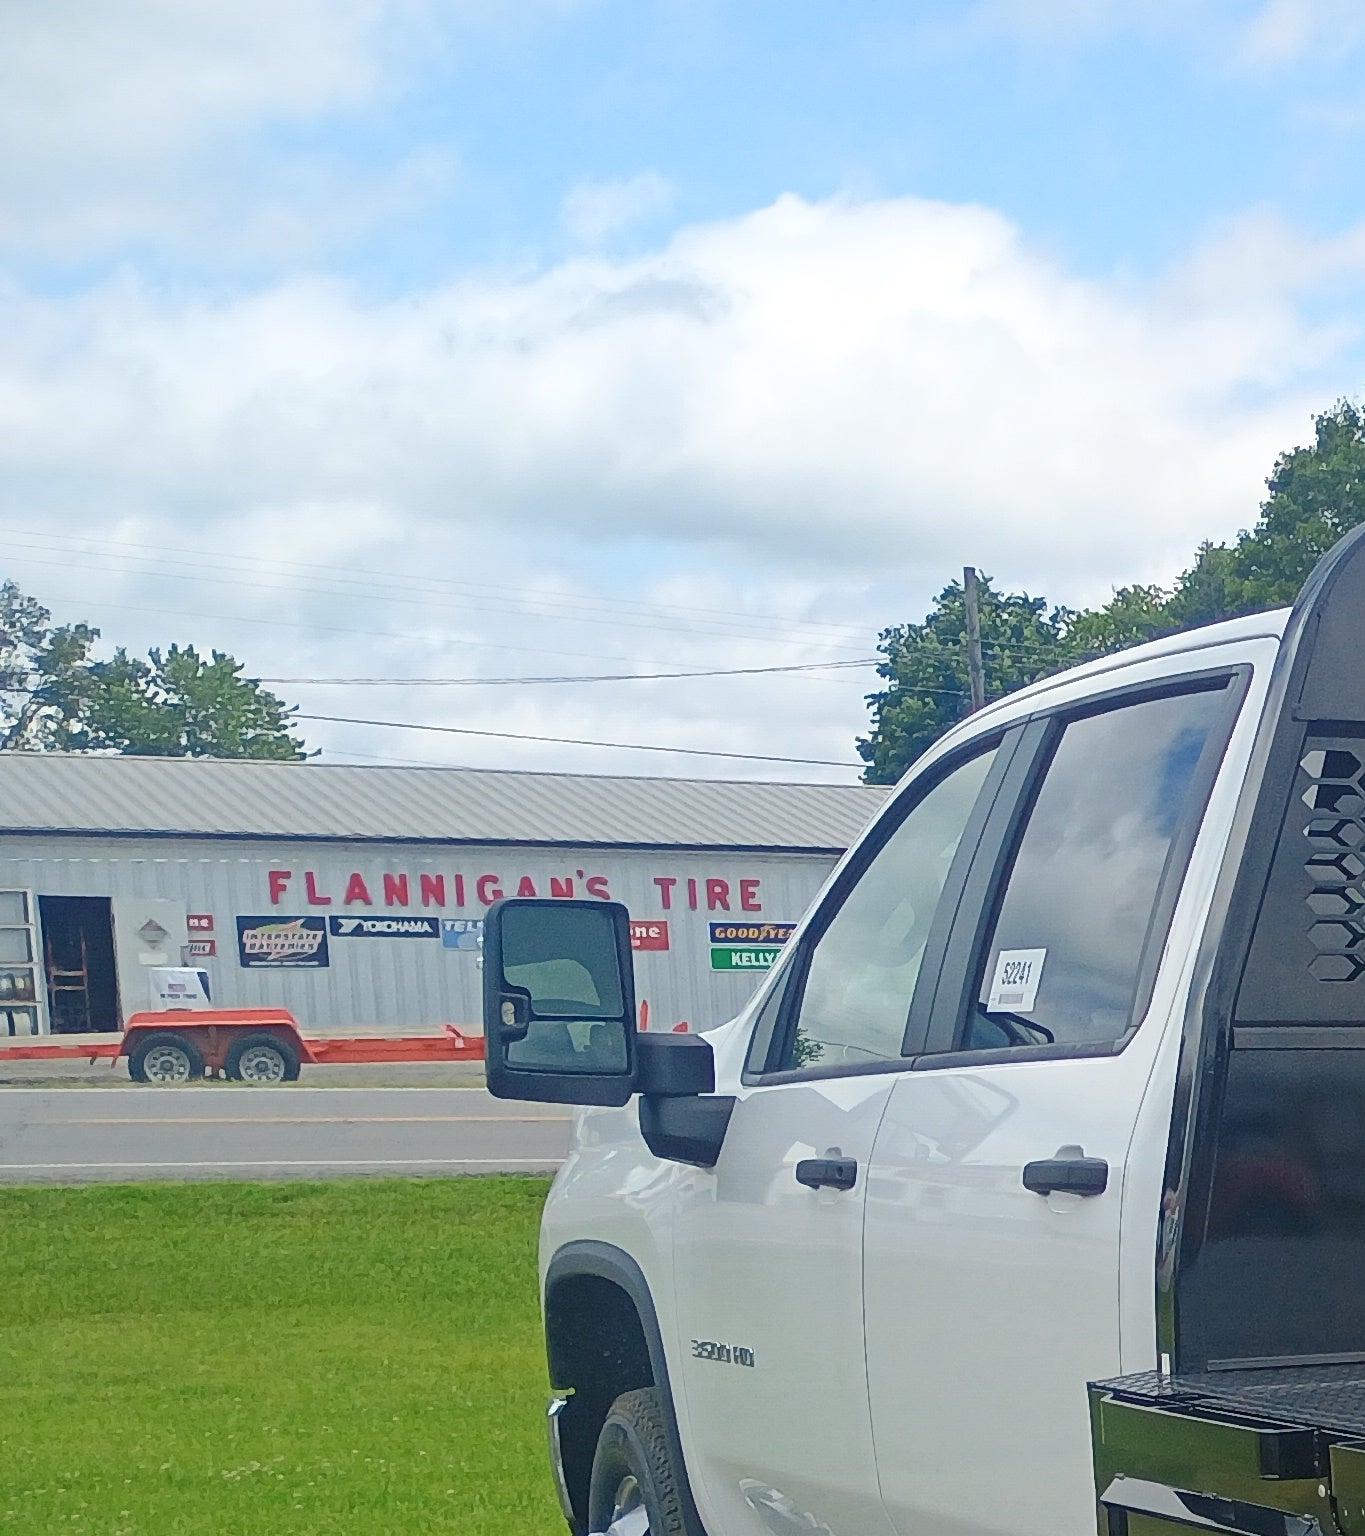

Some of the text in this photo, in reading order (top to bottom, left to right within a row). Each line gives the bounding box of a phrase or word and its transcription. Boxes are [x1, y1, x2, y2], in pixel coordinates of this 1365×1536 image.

[268, 869, 762, 912] FLANNIGAN'S TIRE
[361, 919, 434, 934] YOKOHAMA
[246, 933, 318, 941] INTERSTATE
[249, 942, 314, 951] BATTERIES
[731, 952, 775, 966] KELLY
[690, 1340, 755, 1368] 3500 HD
